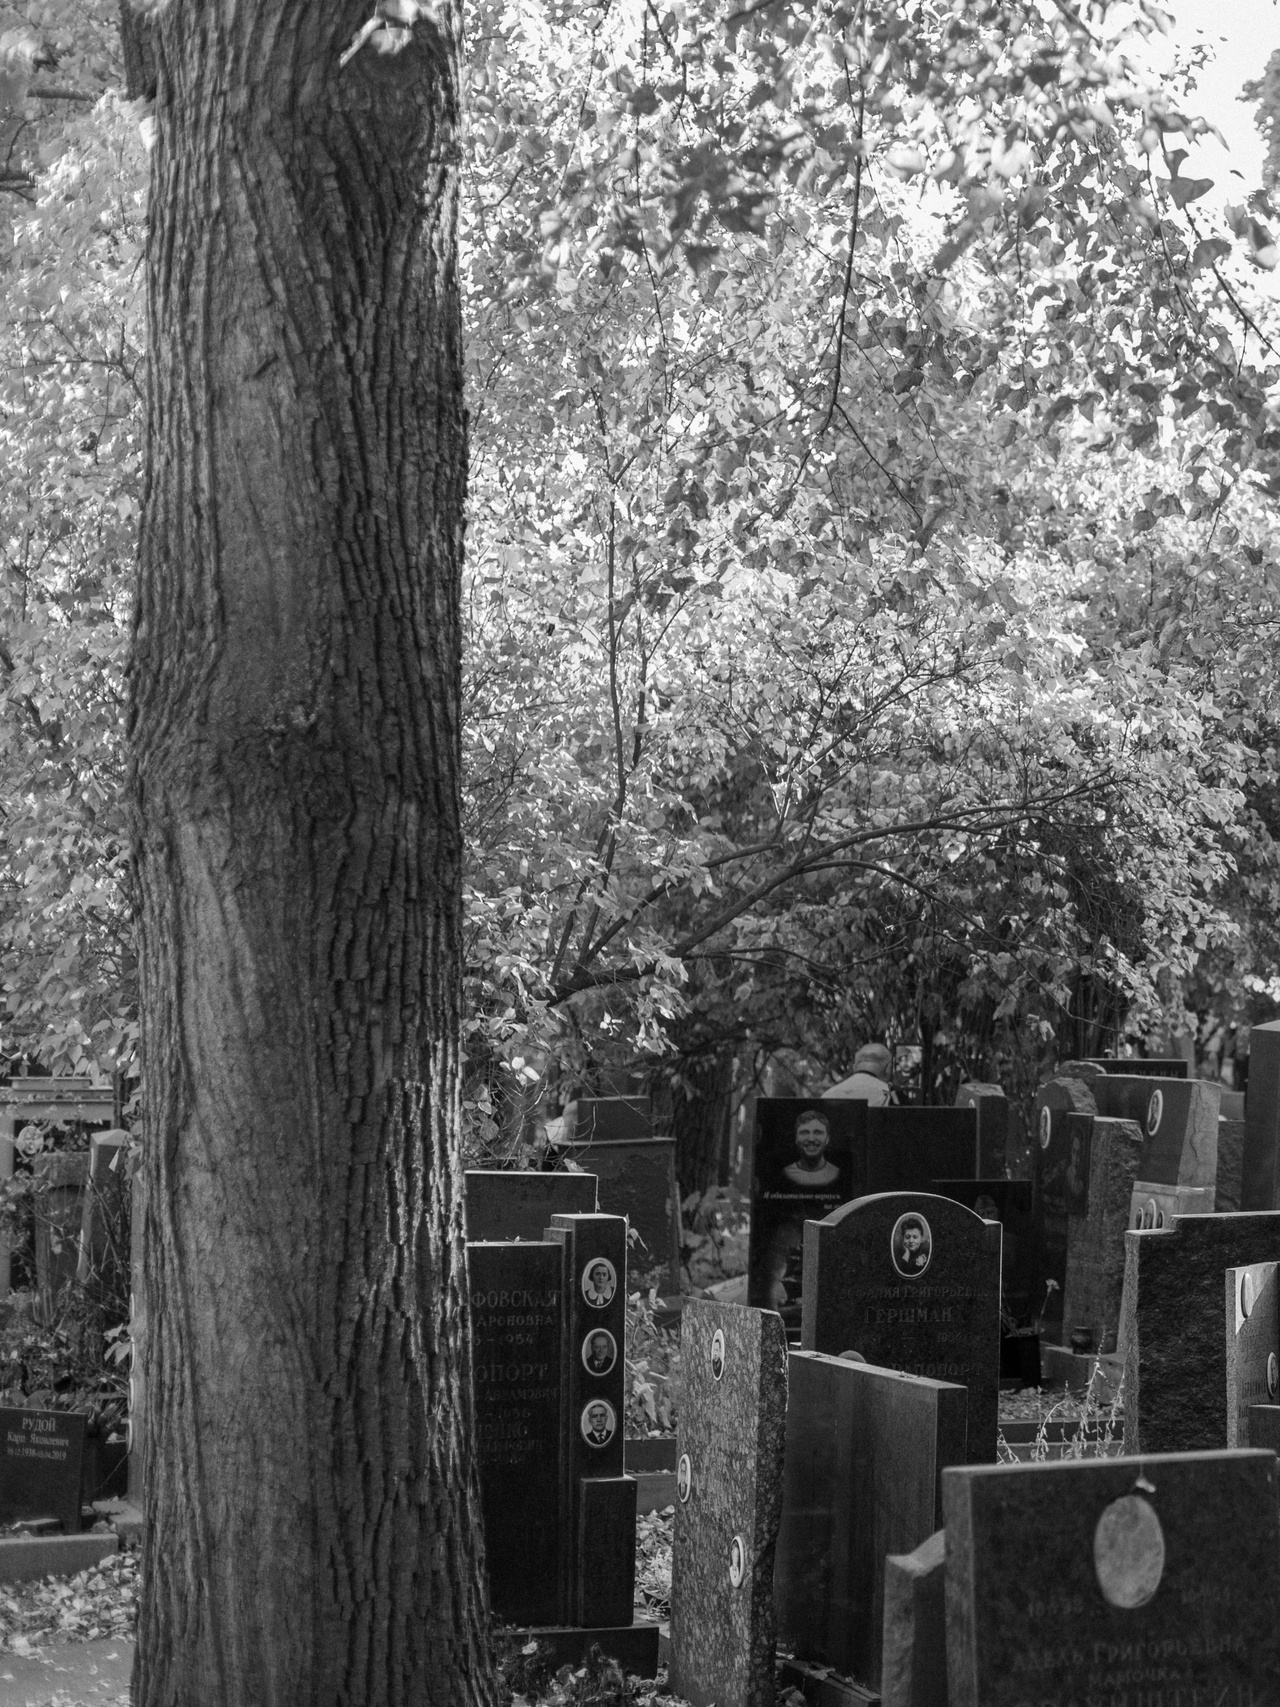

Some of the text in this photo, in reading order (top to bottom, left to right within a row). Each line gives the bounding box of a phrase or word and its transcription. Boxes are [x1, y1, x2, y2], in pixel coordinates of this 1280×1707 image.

[471, 1289, 560, 1308] ФОВСКАЯ
[863, 1305, 954, 1324] ГЕРШМАН
[474, 1362, 550, 1383] ОПОРТ
[21, 1417, 58, 1434] РУДОЙ
[7, 1431, 70, 1447] Карп Яковлевич
